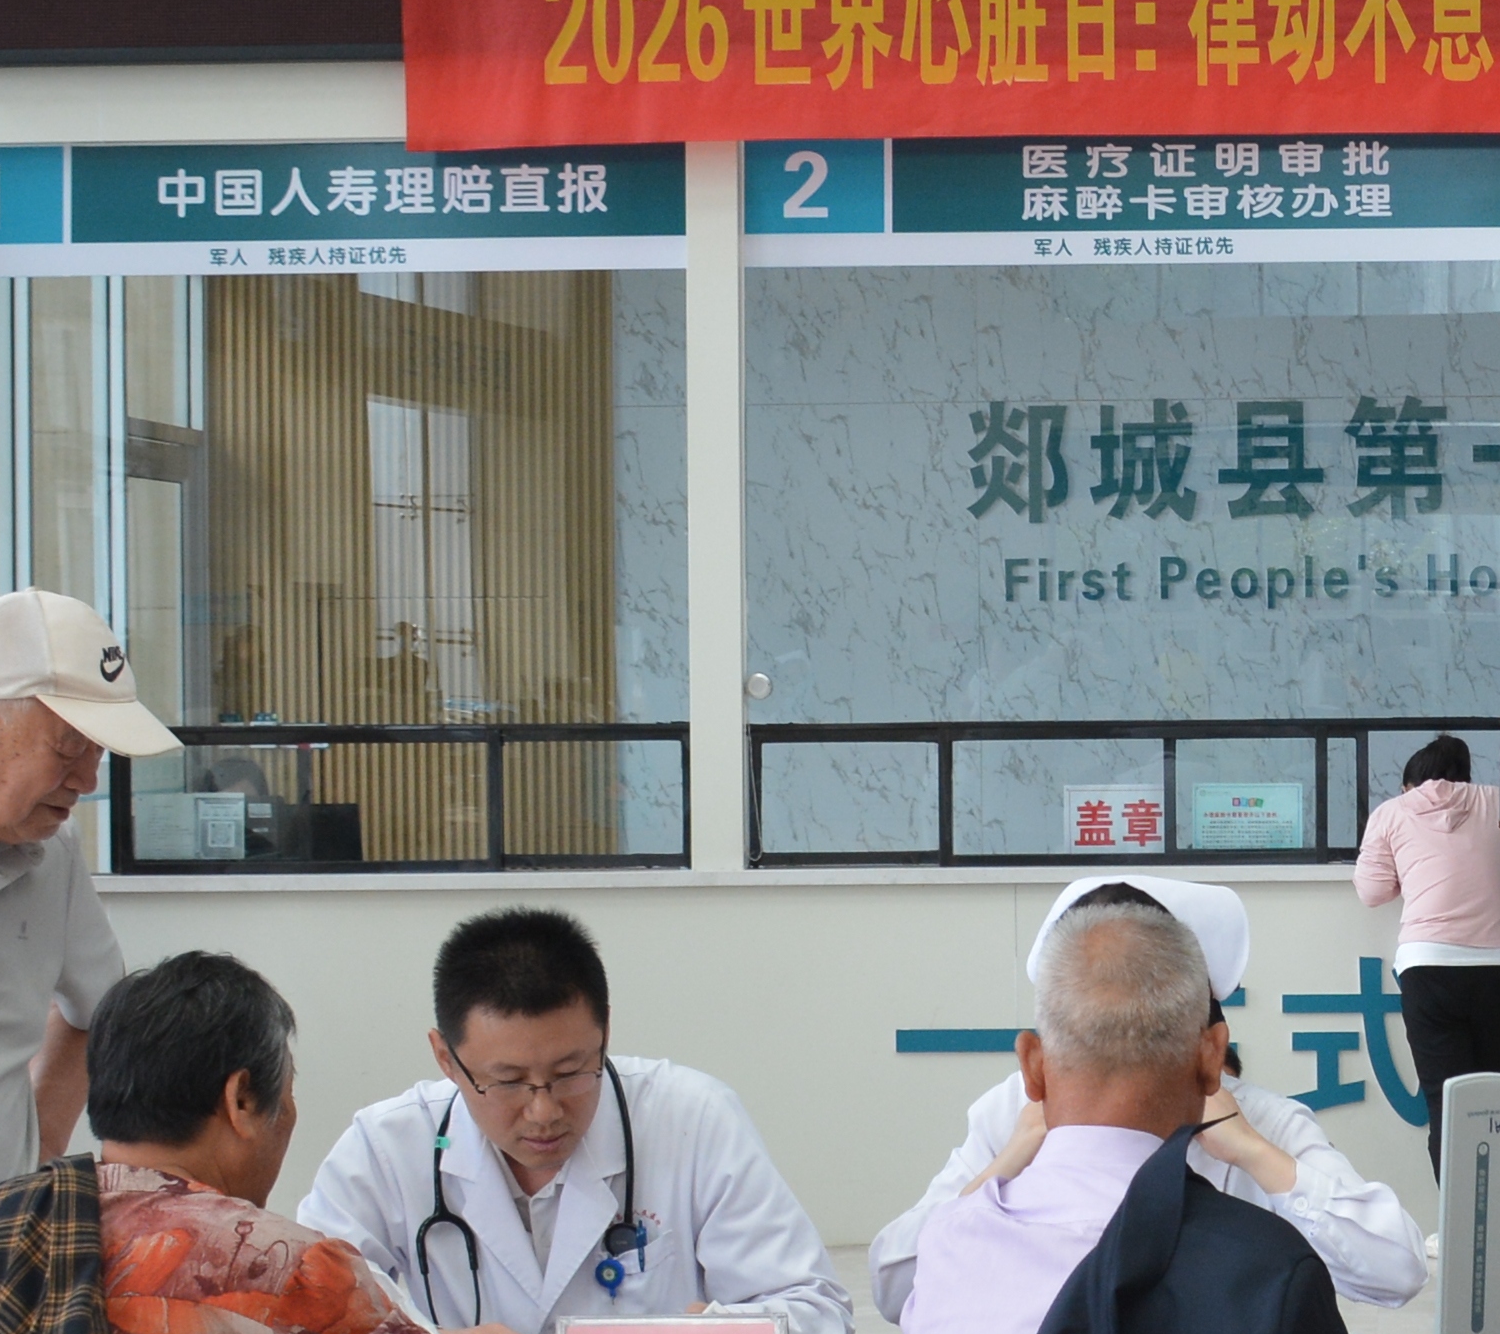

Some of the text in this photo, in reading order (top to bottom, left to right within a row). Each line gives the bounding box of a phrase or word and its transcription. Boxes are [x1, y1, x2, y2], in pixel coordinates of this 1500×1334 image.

[1020, 140, 1392, 180] 医疗证明审批
[159, 161, 612, 217] 中国人寿理赔直报
[782, 151, 831, 217] 2
[1018, 181, 1392, 223] 麻醉卡审核办理
[210, 247, 406, 266] 军人 残疾人持证优先
[1034, 237, 1233, 256] 军人 残疾人持证优先
[1003, 556, 1132, 603] First
[1157, 555, 1399, 610] People's
[1074, 799, 1164, 847] 盖章
